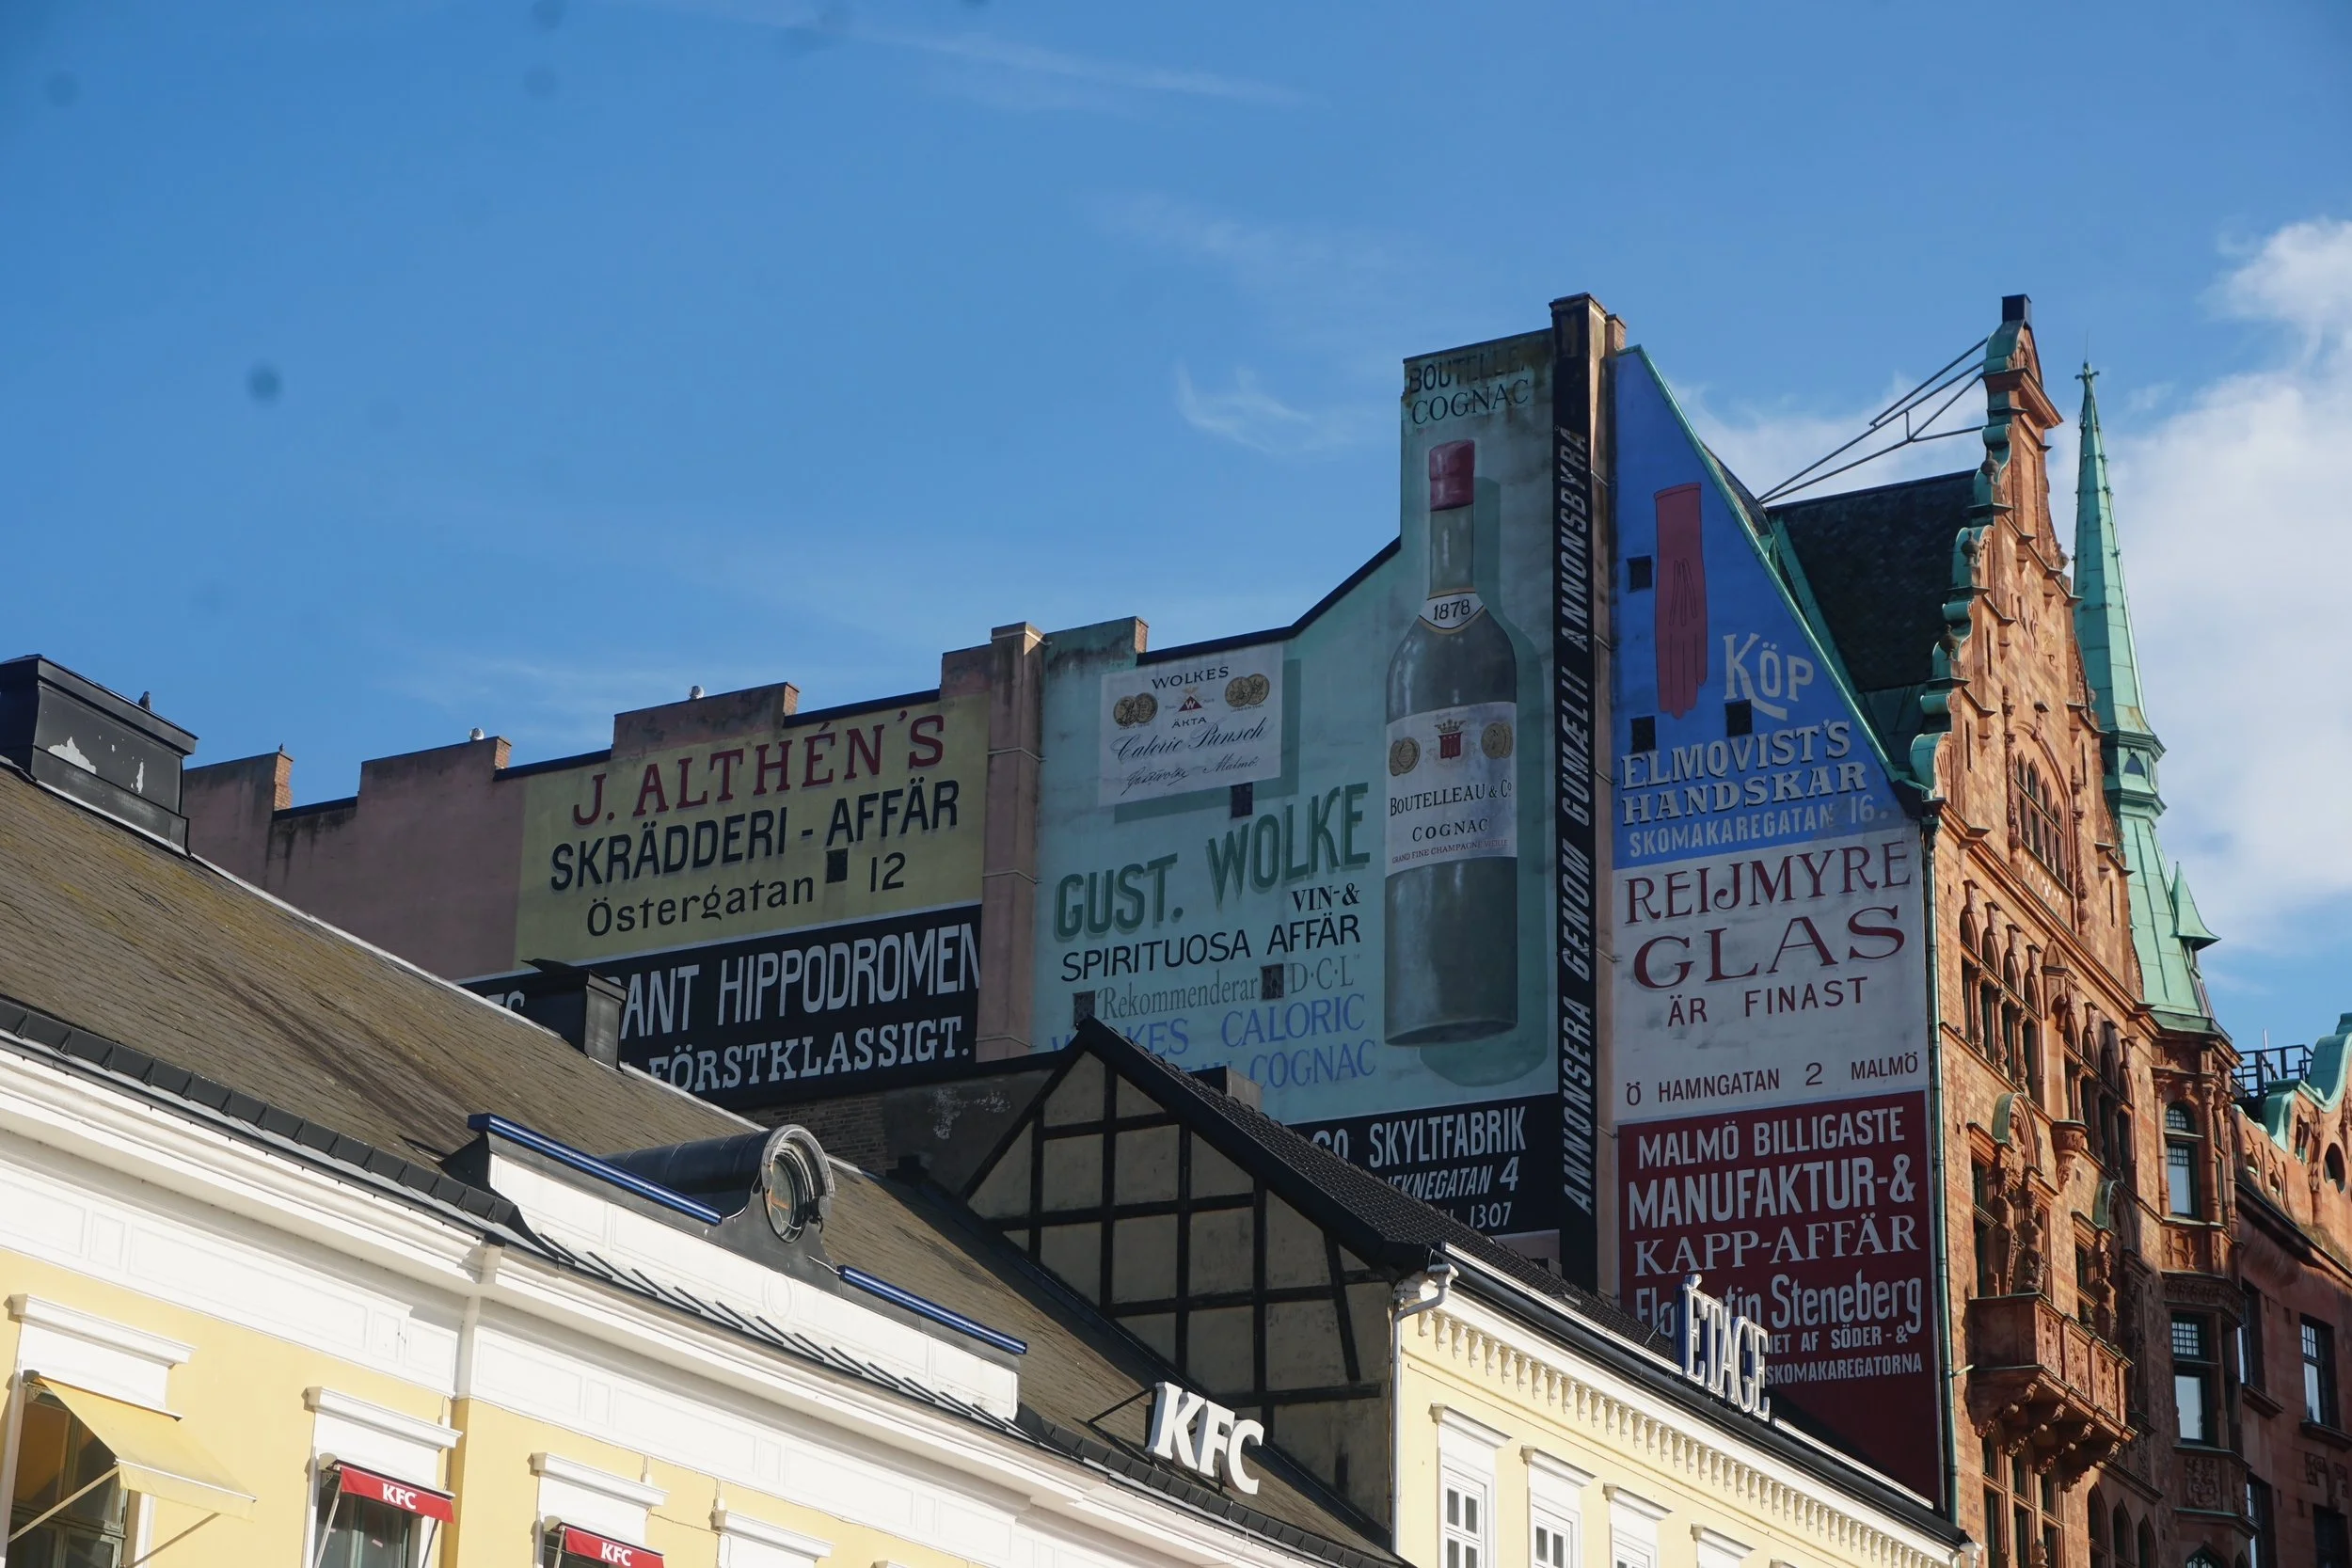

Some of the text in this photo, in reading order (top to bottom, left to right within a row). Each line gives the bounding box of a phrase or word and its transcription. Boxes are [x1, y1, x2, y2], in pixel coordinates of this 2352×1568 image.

[1412, 378, 1529, 425] COGNAC
[1433, 599, 1470, 621] 1878
[1152, 666, 1230, 689] WOLKES
[1723, 632, 1814, 721] KÖP
[1110, 715, 1268, 765] Caloric Punsch
[1171, 716, 1207, 729] ÄKTA
[572, 709, 946, 826] J. ALTHÉN'S
[1621, 719, 1851, 791] ELMQVIST'S
[1390, 784, 1486, 816] BOUTELLEAU
[1489, 785, 1497, 799] &
[1622, 760, 1867, 825] HANDSKAR
[1412, 818, 1488, 842] COGNAC
[1412, 847, 1430, 859] FINE
[1430, 841, 1483, 856] CHAMPAGNE
[1629, 803, 1834, 858] SKOMAKAREGATAN
[1056, 782, 1371, 941] GUST. WOLKE
[1625, 841, 1911, 926] REIJMYRE
[587, 851, 906, 937] Östergatan 12
[1563, 837, 1591, 982] GENOM
[718, 922, 980, 1027] HIPPODROMEN
[1061, 913, 1361, 982] SPIRITUOSA AFFÄR
[1633, 907, 1905, 989] GLAS
[1097, 968, 1259, 1021] Rekommenderar
[1221, 993, 1366, 1048] CALORIC
[1668, 976, 1868, 1027] ÄR FINAST
[648, 1015, 970, 1093] FÖRSTKLASSIGT.
[1249, 1039, 1376, 1091] COGNAC
[1627, 1052, 1918, 1105] Ö HAMNGATAN 2 MALMÖ
[1564, 997, 1592, 1215] ANNONSERA
[1369, 1106, 1527, 1168] SKYLTFABRIK
[1638, 1106, 1905, 1170] MALMÖ BILLIGASTE
[1499, 1156, 1519, 1192] 4
[1470, 1201, 1513, 1229] 1307
[1633, 1212, 1920, 1277] KAPP-AFFÄR
[1771, 1268, 1923, 1335] Steneberg
[1682, 1273, 1771, 1422] ÉTAGE
[1765, 1353, 1923, 1386] SKOMAKAREGATORNA
[1801, 1334, 1820, 1352] AF
[1145, 1381, 1264, 1495] KFC
[382, 1482, 417, 1510] KFC
[600, 1542, 631, 1568] KFC
